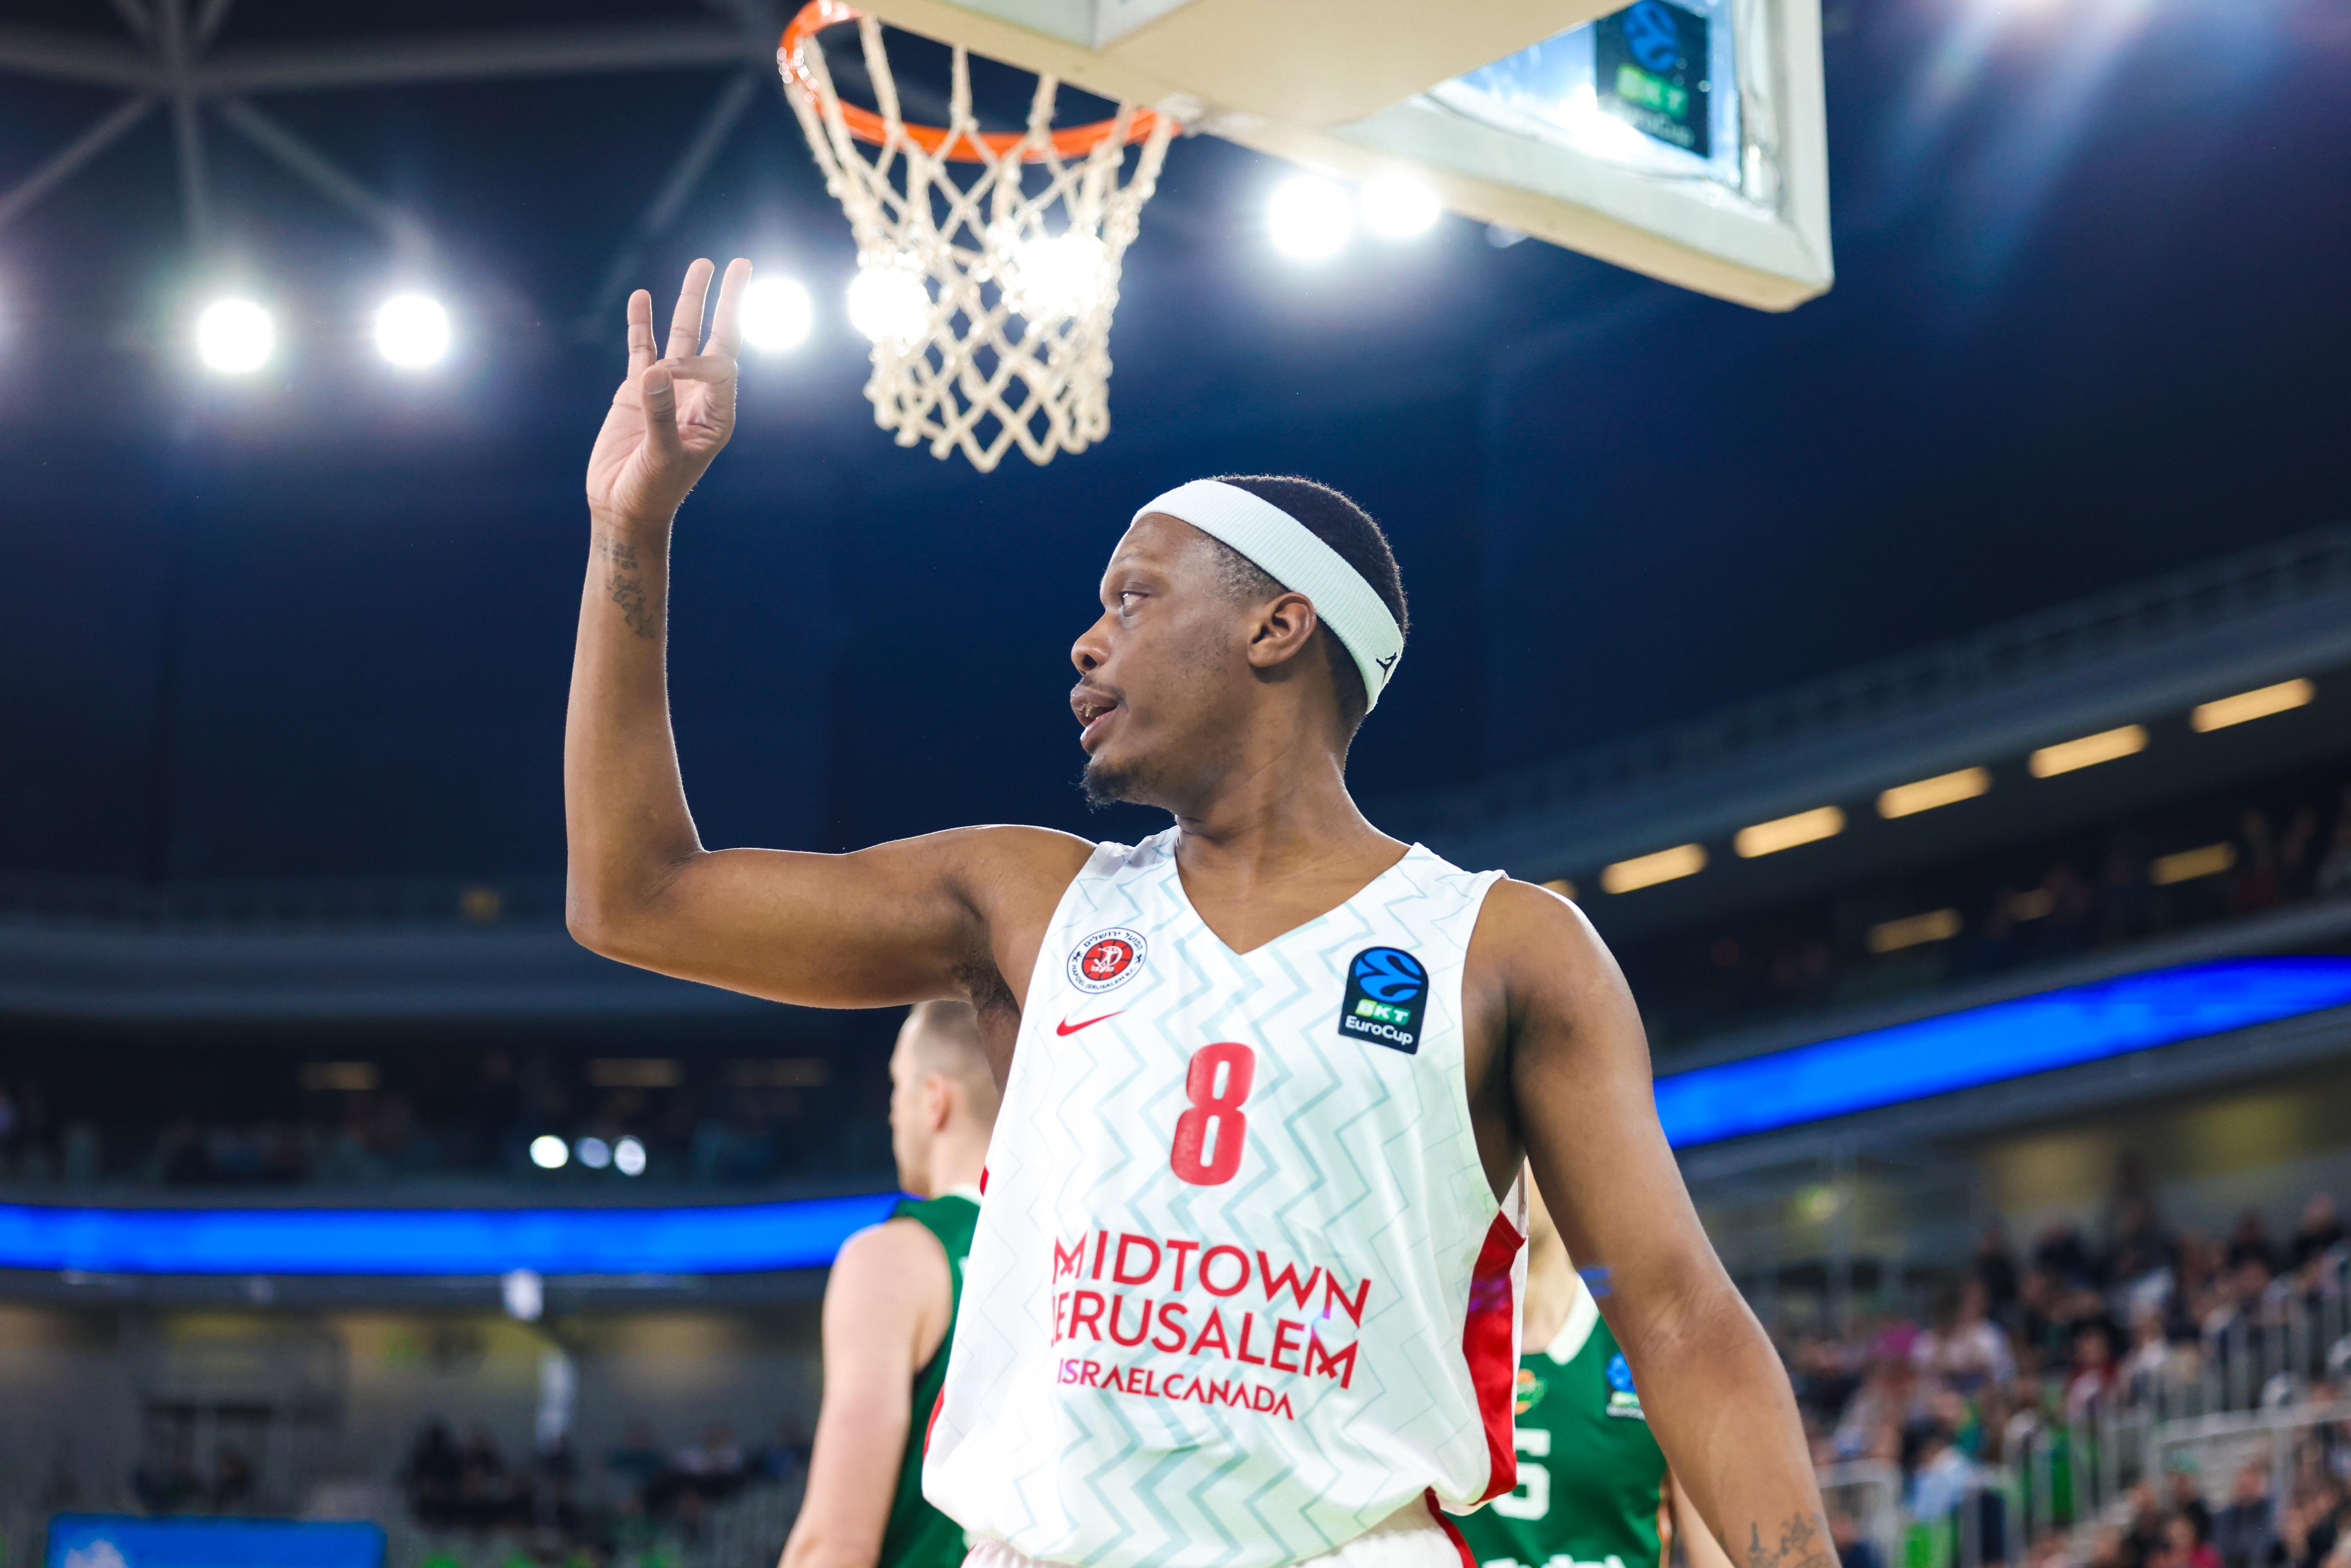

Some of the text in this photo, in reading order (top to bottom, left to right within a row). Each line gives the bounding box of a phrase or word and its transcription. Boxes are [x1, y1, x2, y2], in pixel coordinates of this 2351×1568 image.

[1345, 1015, 1413, 1045] EuroCup
[1170, 1042, 1256, 1186] 8
[1052, 1229, 1372, 1329] MIDTOWN
